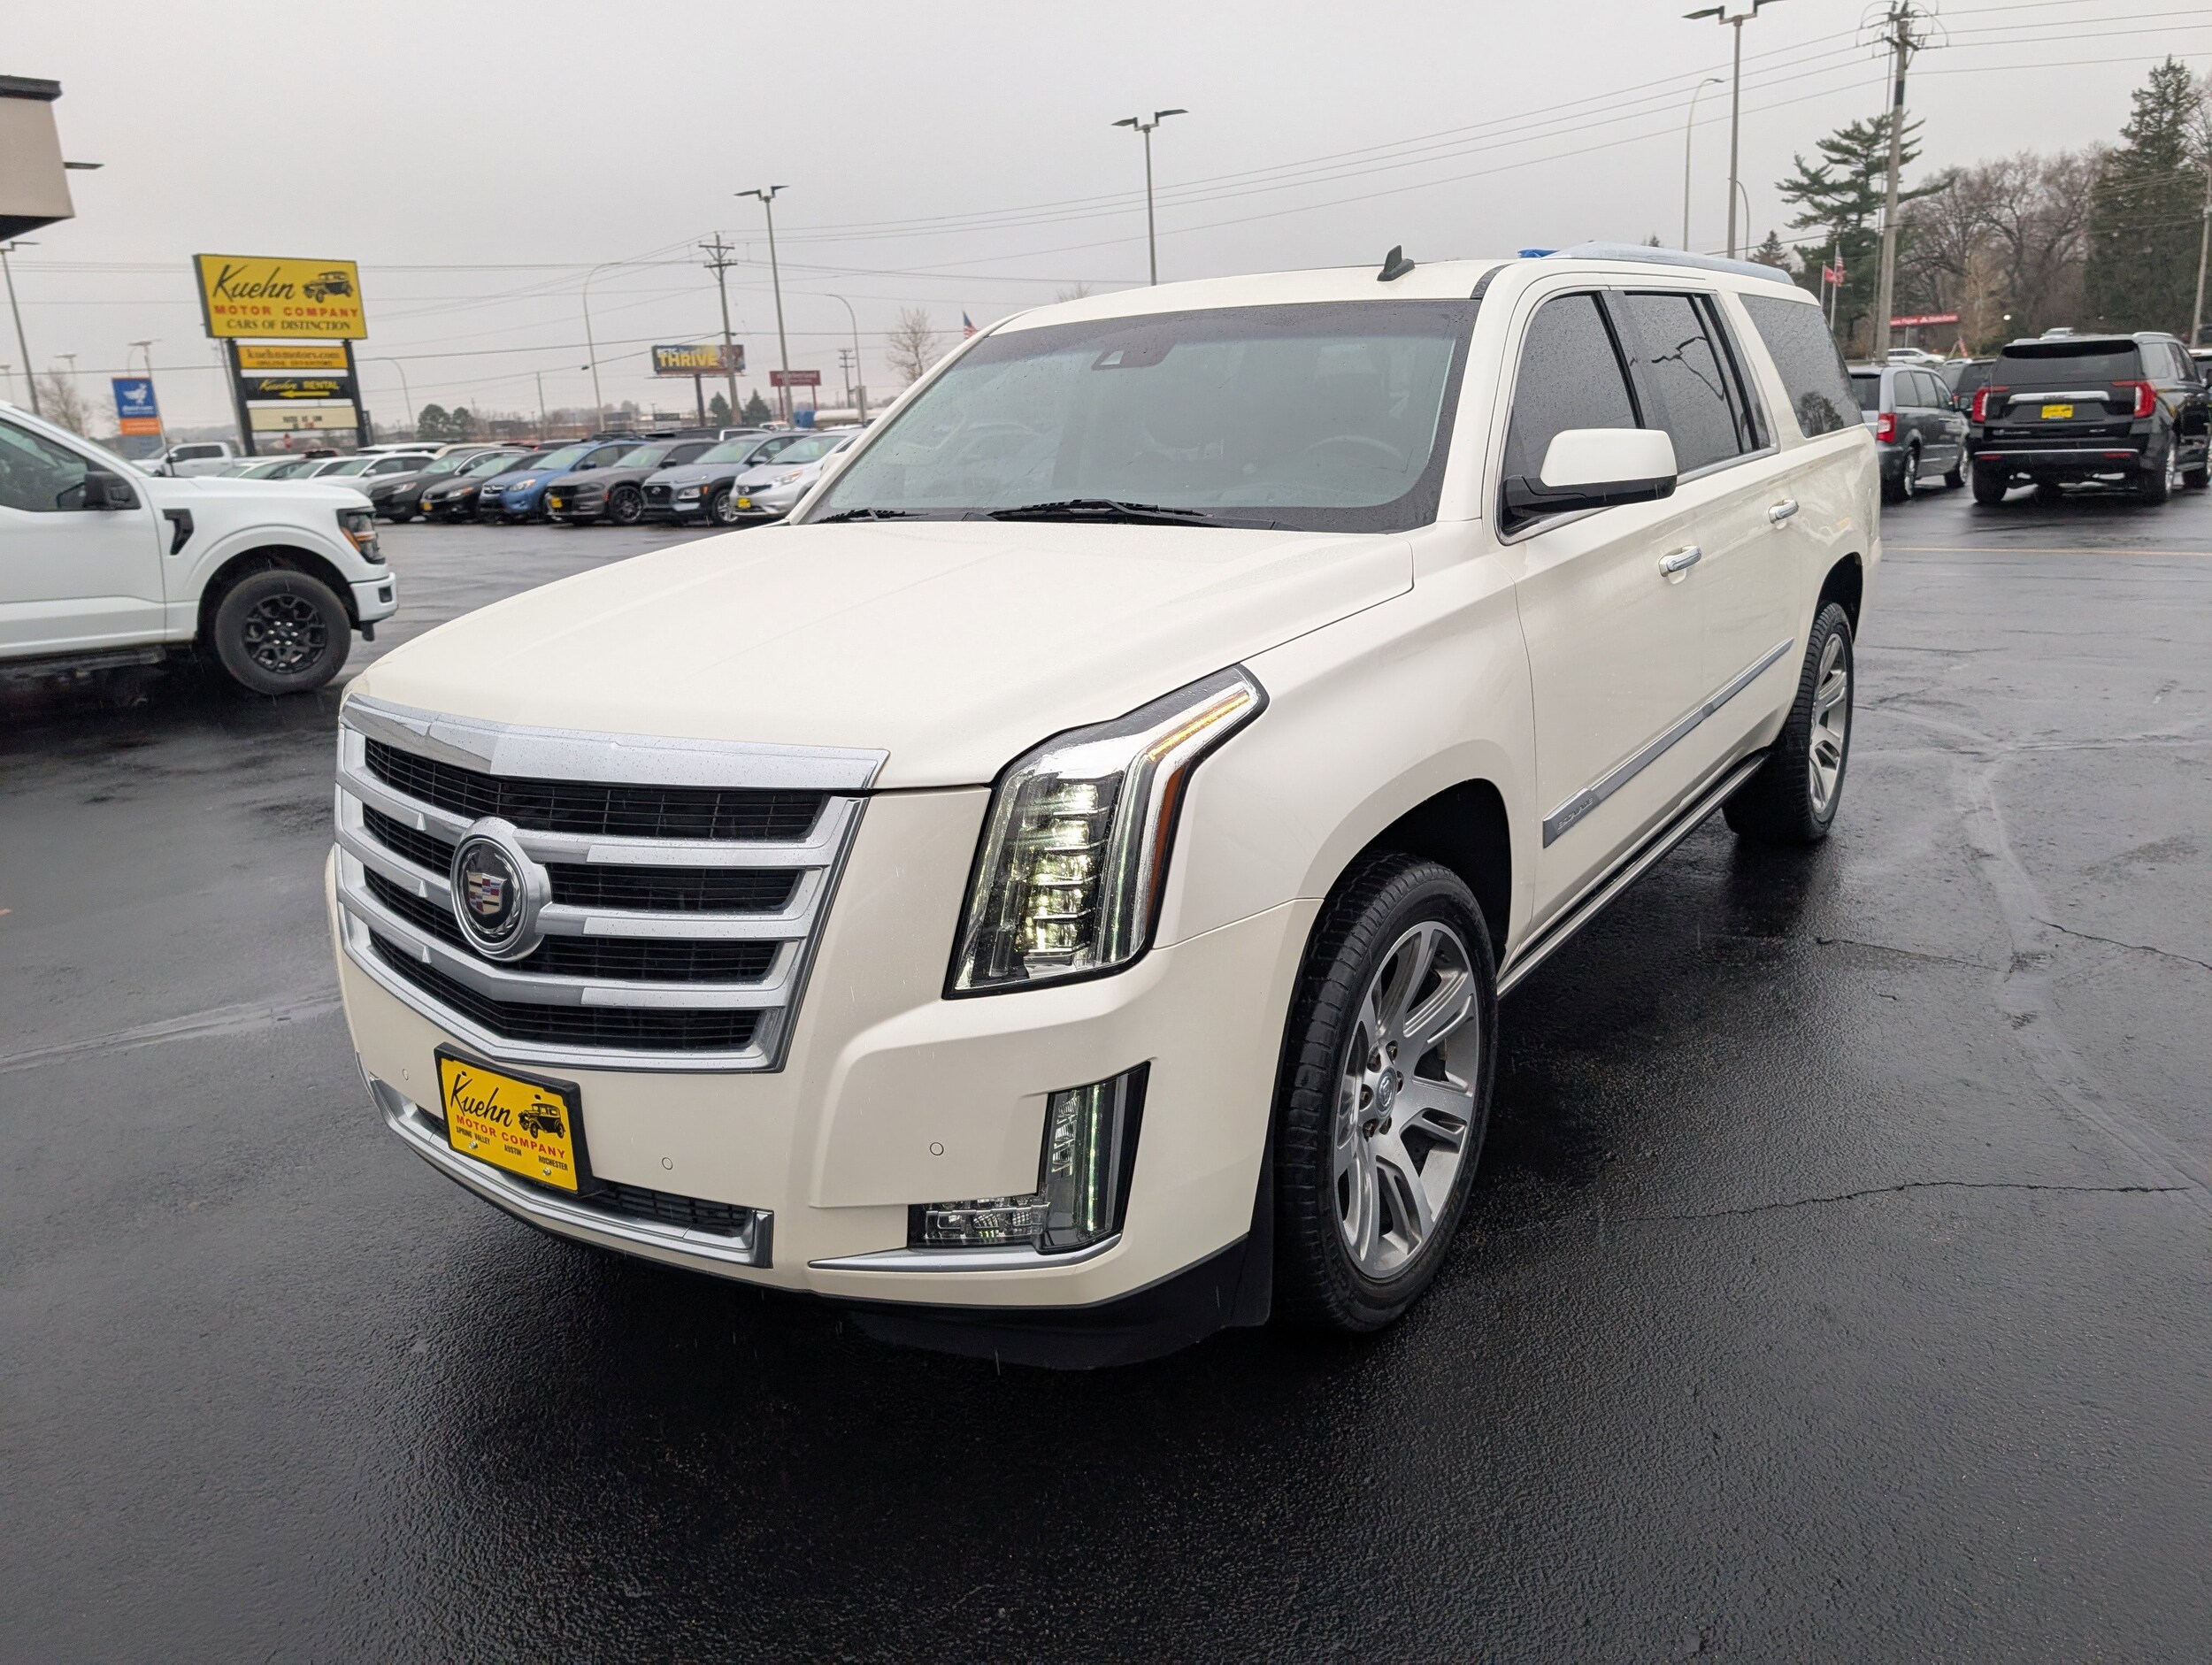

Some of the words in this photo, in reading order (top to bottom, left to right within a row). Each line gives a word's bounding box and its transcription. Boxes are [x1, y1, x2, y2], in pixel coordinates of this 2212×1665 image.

[212, 264, 296, 302] Kuehn
[213, 305, 272, 315] MOTOR
[283, 308, 358, 318] COMPANY
[227, 318, 258, 329] CARS
[262, 319, 277, 329] OF
[280, 319, 350, 331] DISTINCTION
[657, 352, 720, 367] THRIVE
[259, 380, 297, 391] Kuehn
[450, 1073, 513, 1128] Kuehn
[456, 1125, 472, 1139] SPRING
[474, 1132, 491, 1146] VALLEY
[456, 1115, 497, 1138] MOTOR
[501, 1132, 566, 1159] COMPANY
[503, 1145, 522, 1156] AUSTIN
[538, 1155, 569, 1171] ROCHESTER
